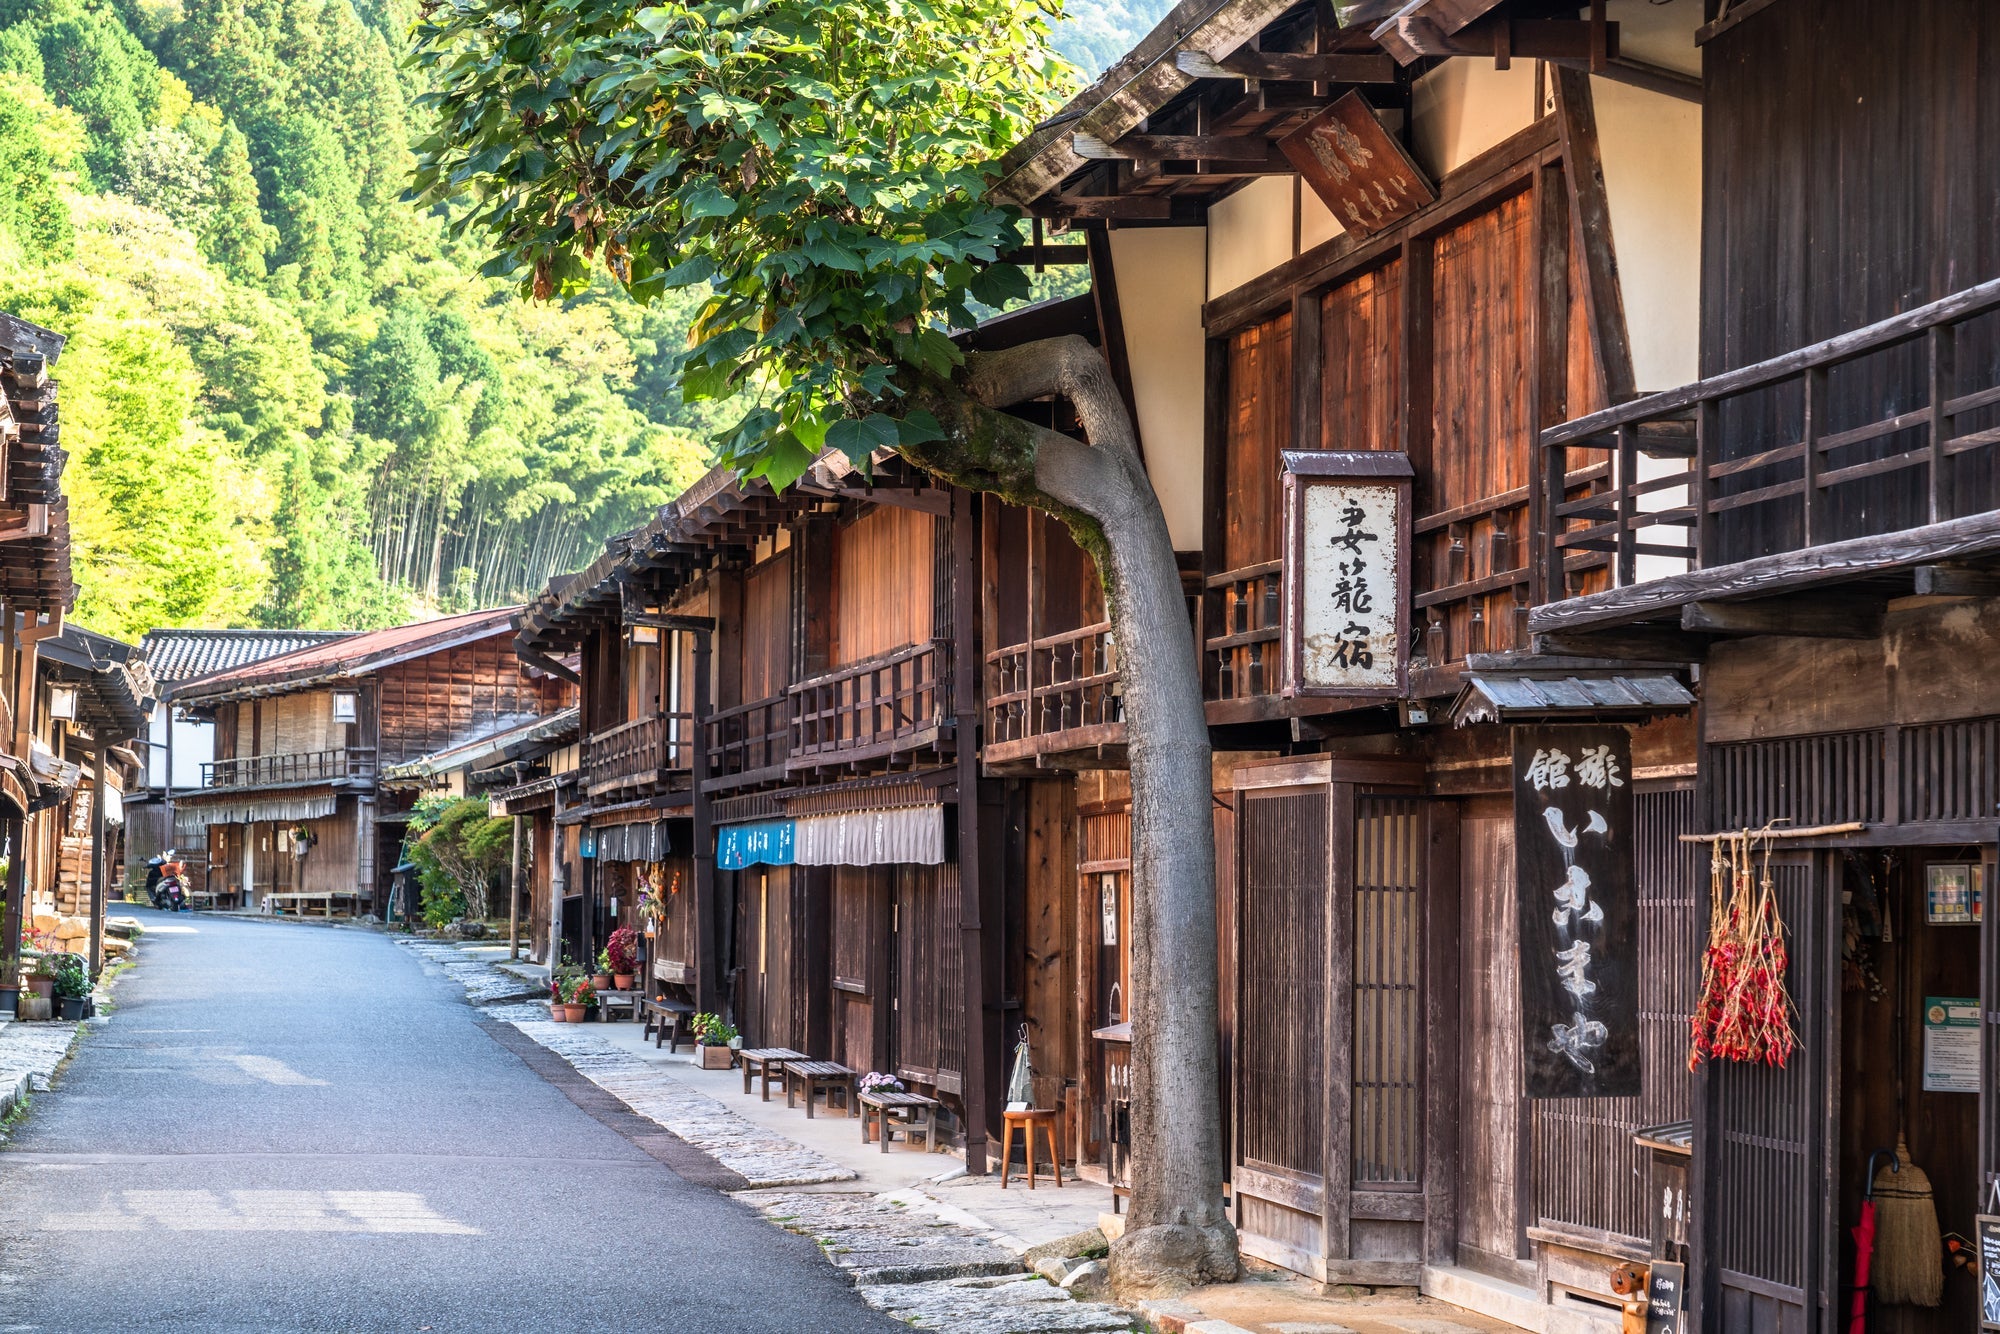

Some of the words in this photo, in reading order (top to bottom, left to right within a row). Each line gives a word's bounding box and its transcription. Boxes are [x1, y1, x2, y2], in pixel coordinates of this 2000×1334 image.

[1327, 498, 1378, 670] 妻籠宿
[1523, 744, 1625, 791] 旅館
